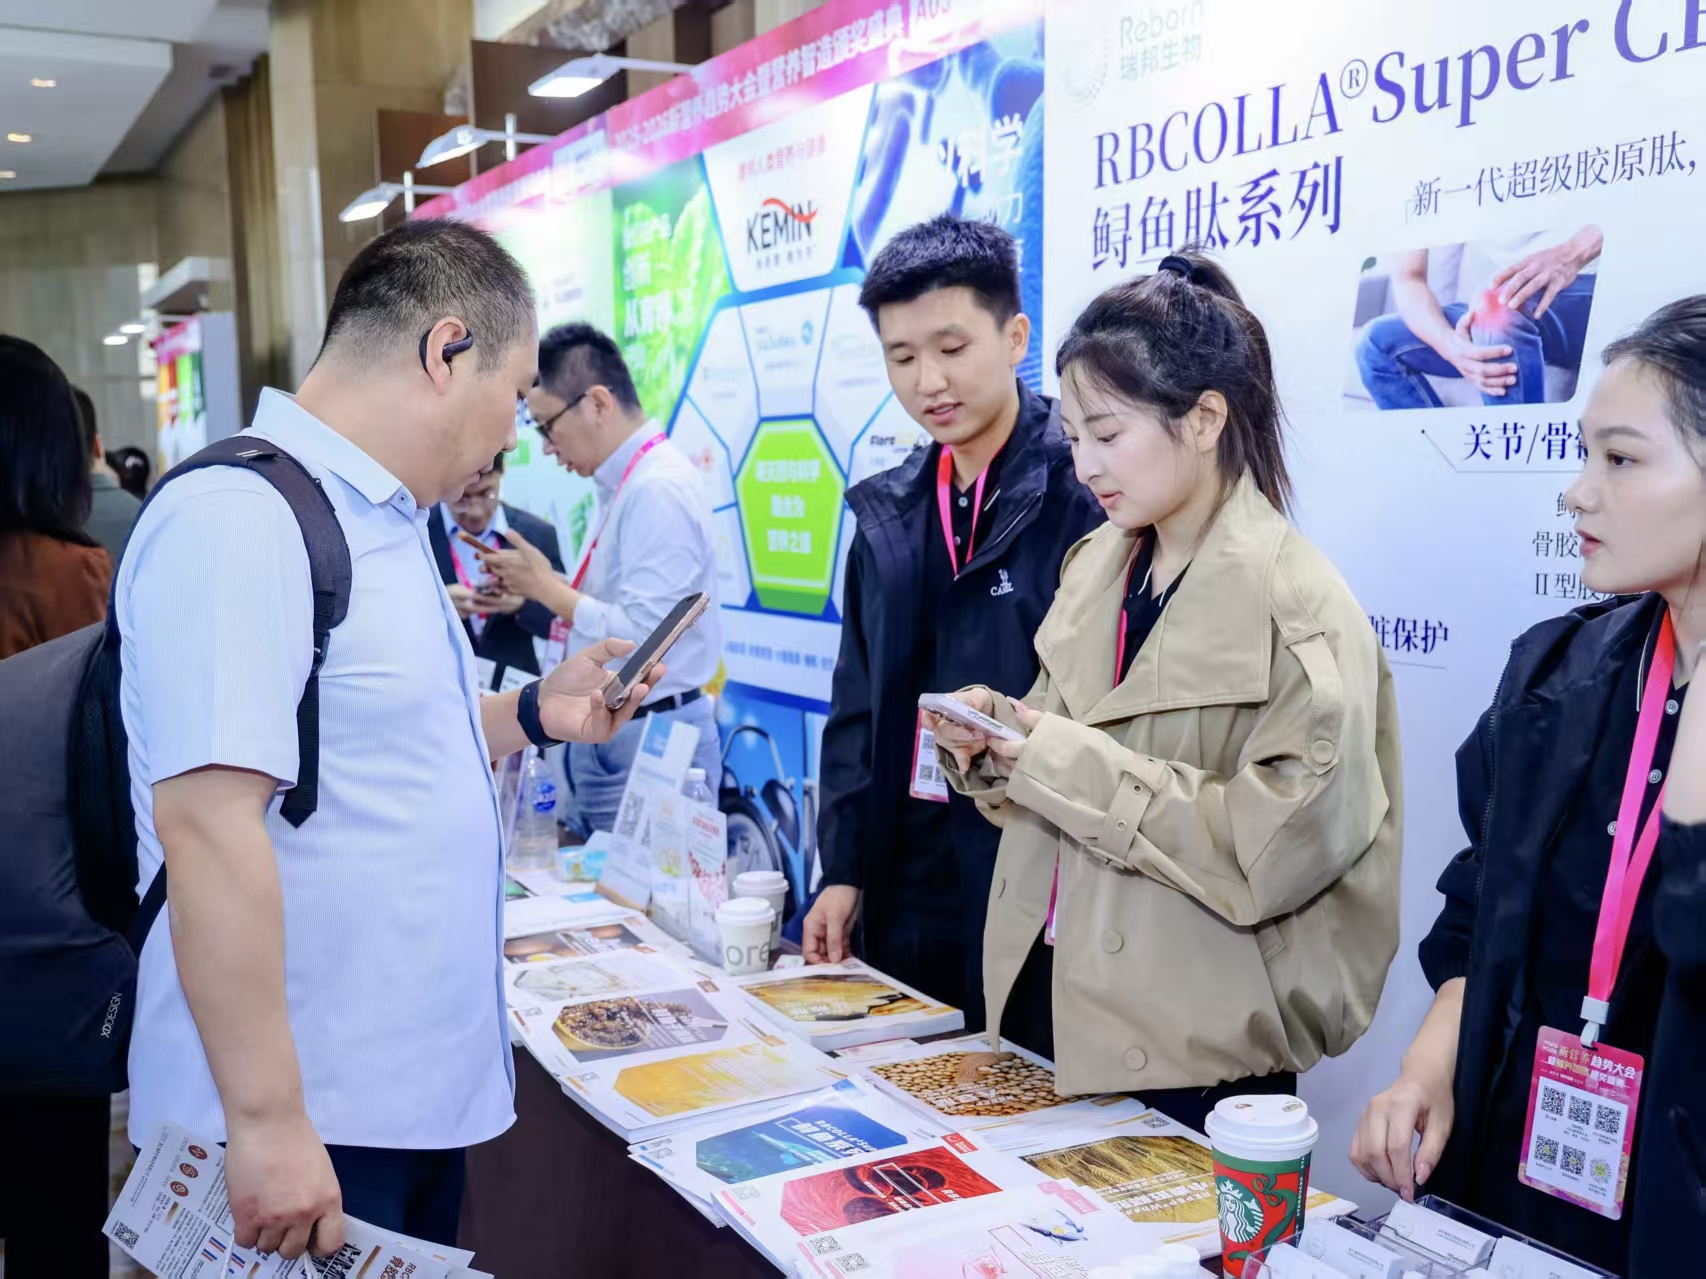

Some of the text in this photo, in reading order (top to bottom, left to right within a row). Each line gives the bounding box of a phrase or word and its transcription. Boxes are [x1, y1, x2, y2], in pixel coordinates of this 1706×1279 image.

[746, 200, 813, 254] KEMIN
[1092, 156, 1344, 271] 鲟鱼肽系列
[1532, 530, 1583, 558] 骨胶
